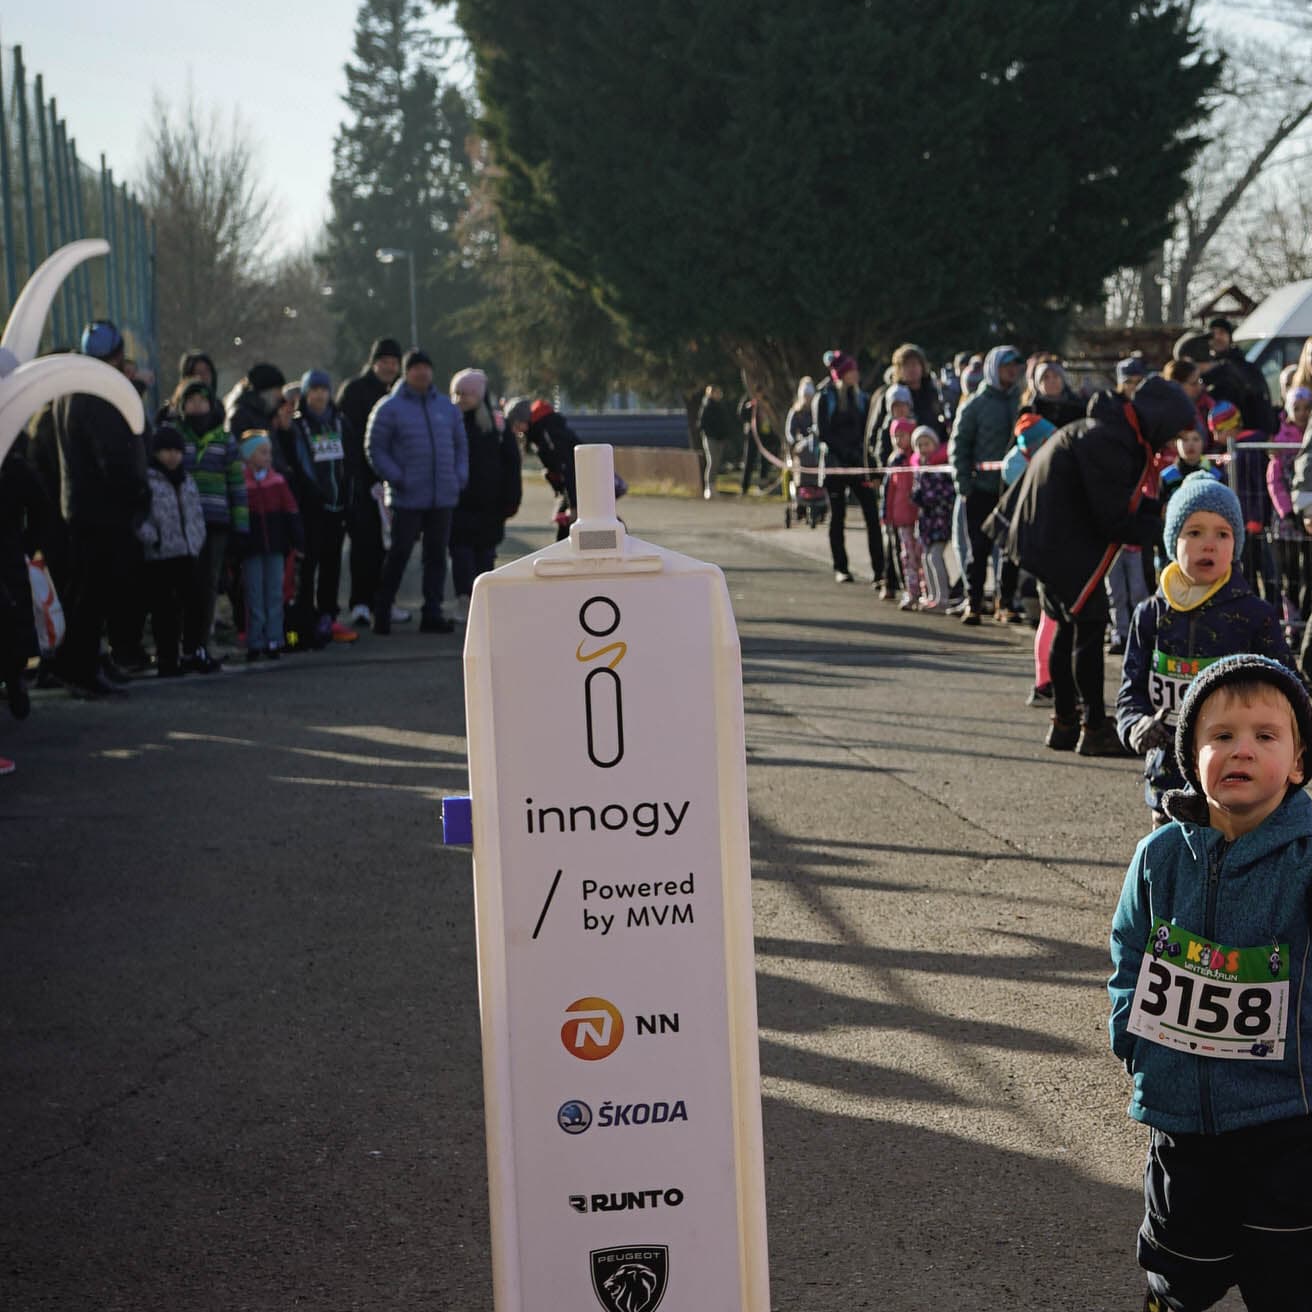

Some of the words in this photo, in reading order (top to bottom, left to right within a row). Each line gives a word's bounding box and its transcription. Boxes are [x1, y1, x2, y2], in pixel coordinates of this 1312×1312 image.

[525, 797, 691, 837] innogy
[583, 872, 695, 901] Powered
[583, 909, 615, 936] by
[627, 904, 695, 929] MVM
[1140, 962, 1273, 1036] 3158
[635, 1013, 680, 1035] NN
[598, 1100, 688, 1128] ŠKODA
[591, 1188, 684, 1213] RUNTO
[597, 1251, 661, 1264] PEUGEOT
